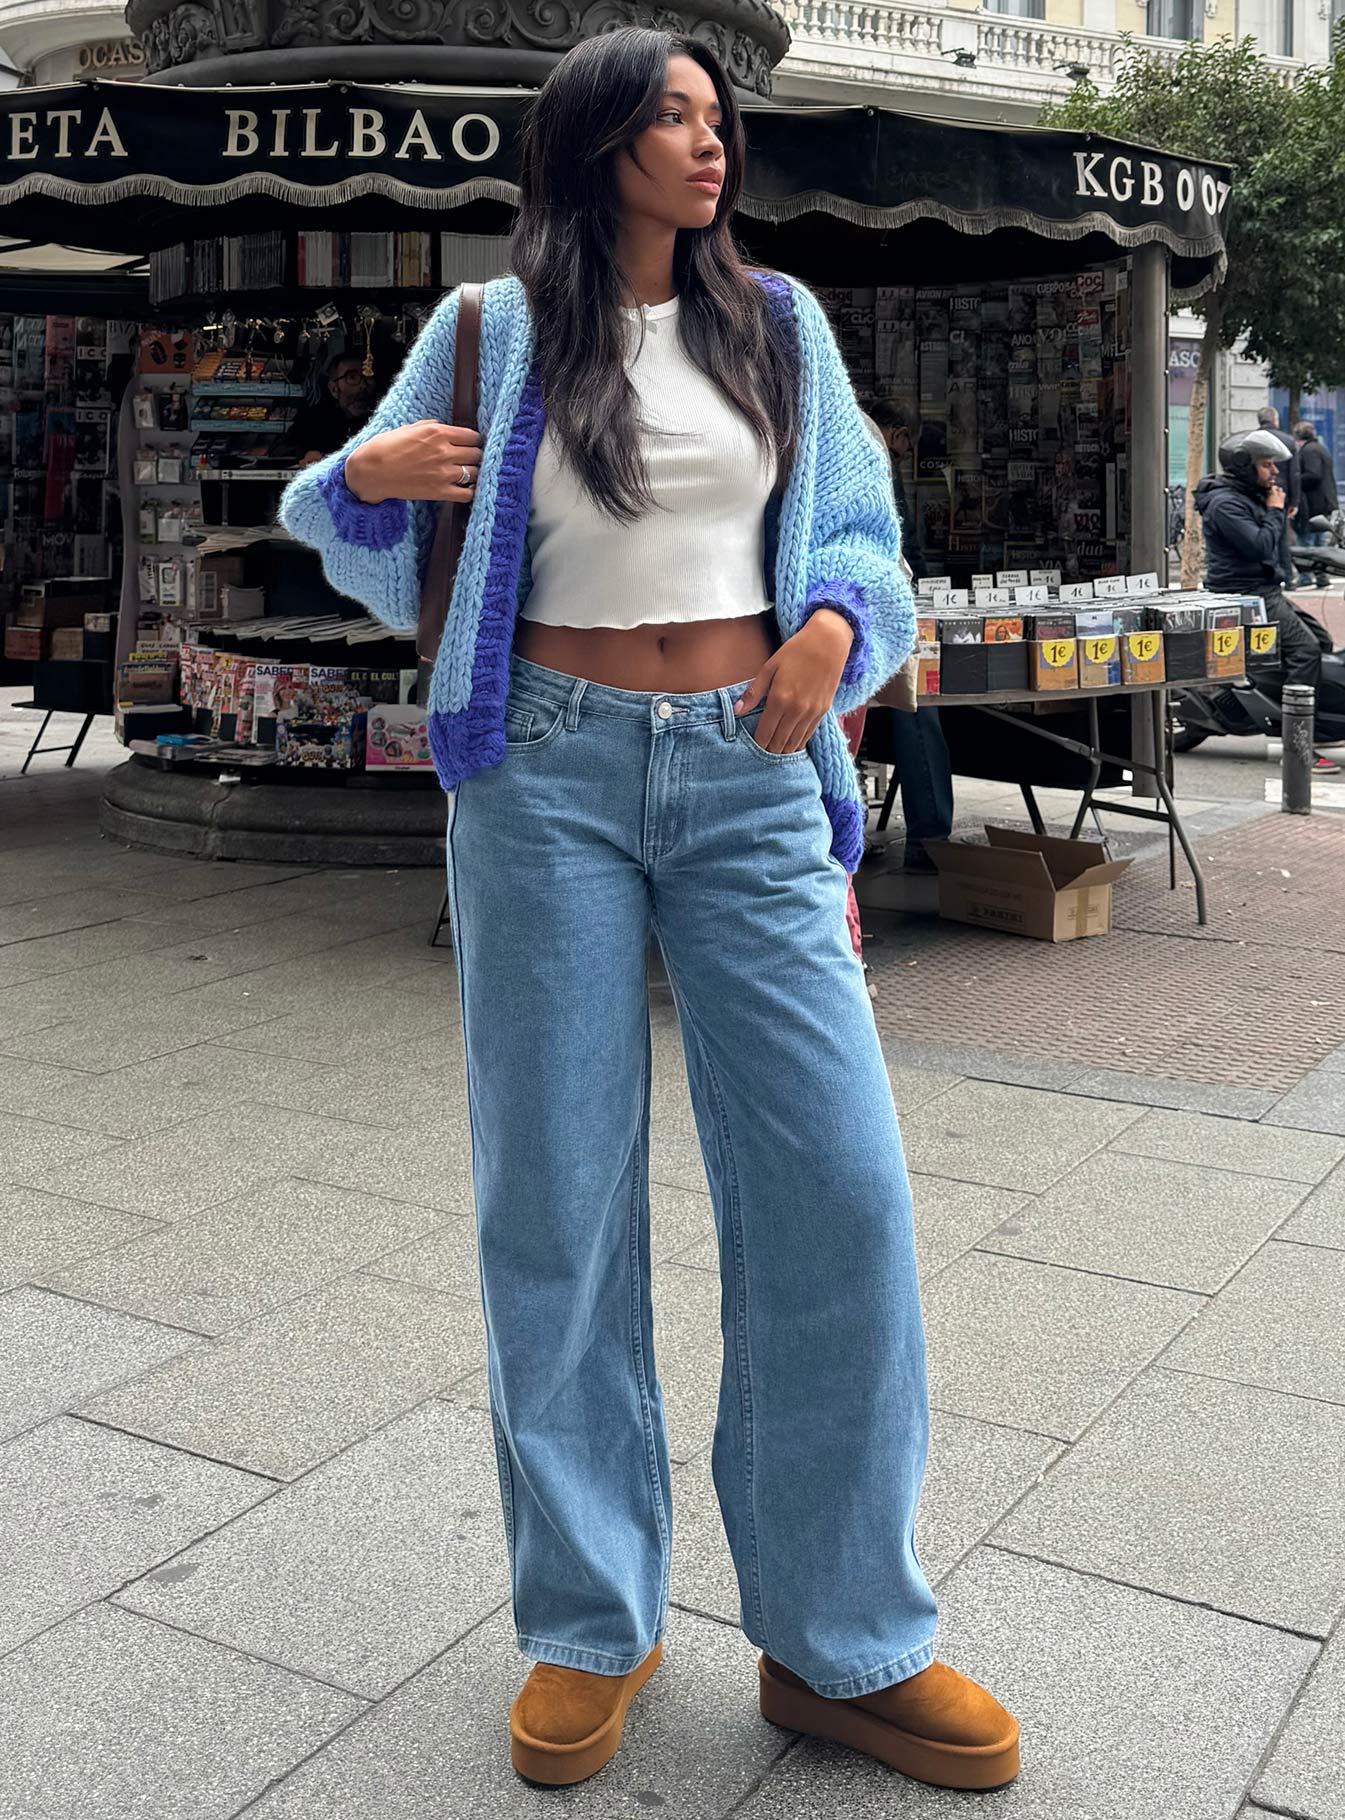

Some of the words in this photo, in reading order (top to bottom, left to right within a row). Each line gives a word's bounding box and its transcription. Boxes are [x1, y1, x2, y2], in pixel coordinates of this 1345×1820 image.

[7, 107, 128, 160] ETA
[222, 108, 500, 162] BILBAO
[1073, 152, 1164, 206] KGB
[1137, 640, 1152, 657] 1€
[1217, 635, 1232, 653] 1€
[1255, 633, 1269, 650] 1€
[1050, 645, 1066, 663] 1€
[1092, 642, 1108, 660] 1€
